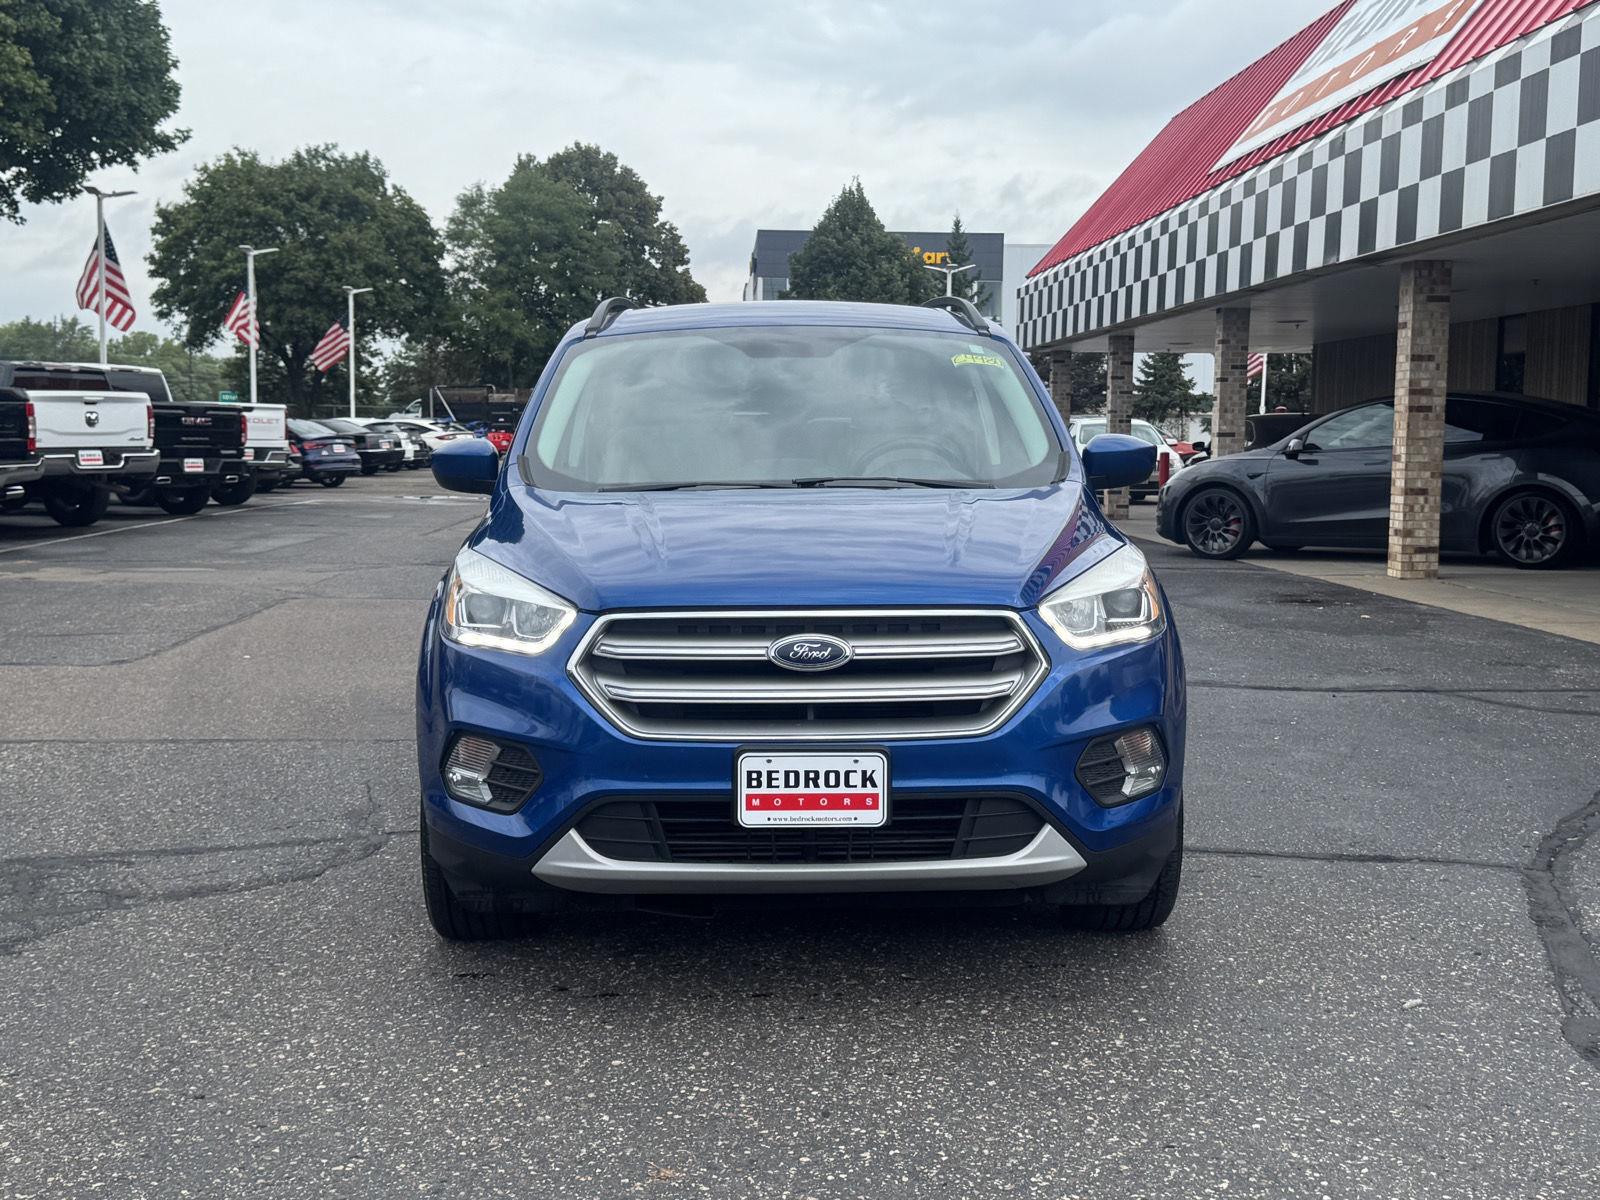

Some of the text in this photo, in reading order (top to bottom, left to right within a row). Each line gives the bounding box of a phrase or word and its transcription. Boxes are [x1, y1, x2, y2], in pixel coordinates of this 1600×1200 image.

[789, 642, 832, 660] Ford
[746, 770, 878, 789] BEDROCK
[752, 797, 873, 806] MOTORS
